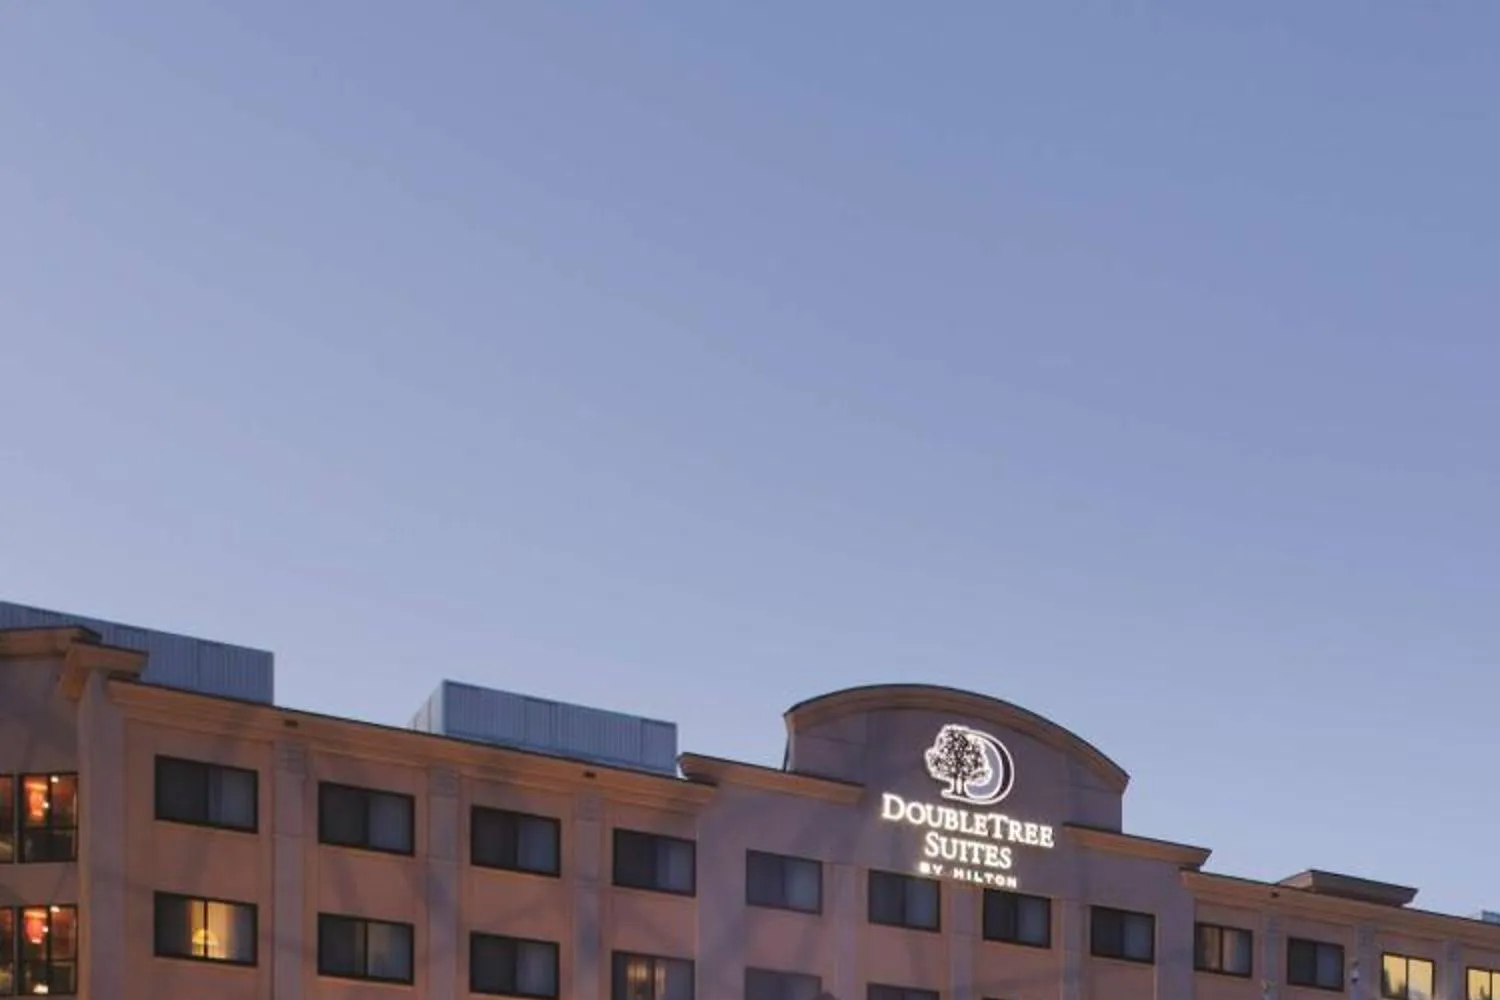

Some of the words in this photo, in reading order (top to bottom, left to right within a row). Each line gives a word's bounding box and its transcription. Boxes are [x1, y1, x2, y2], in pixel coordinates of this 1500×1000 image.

[881, 792, 1055, 849] DOUBLETREE
[924, 831, 1013, 870] SUITES
[917, 861, 943, 875] BY
[953, 867, 1018, 889] HILTON
